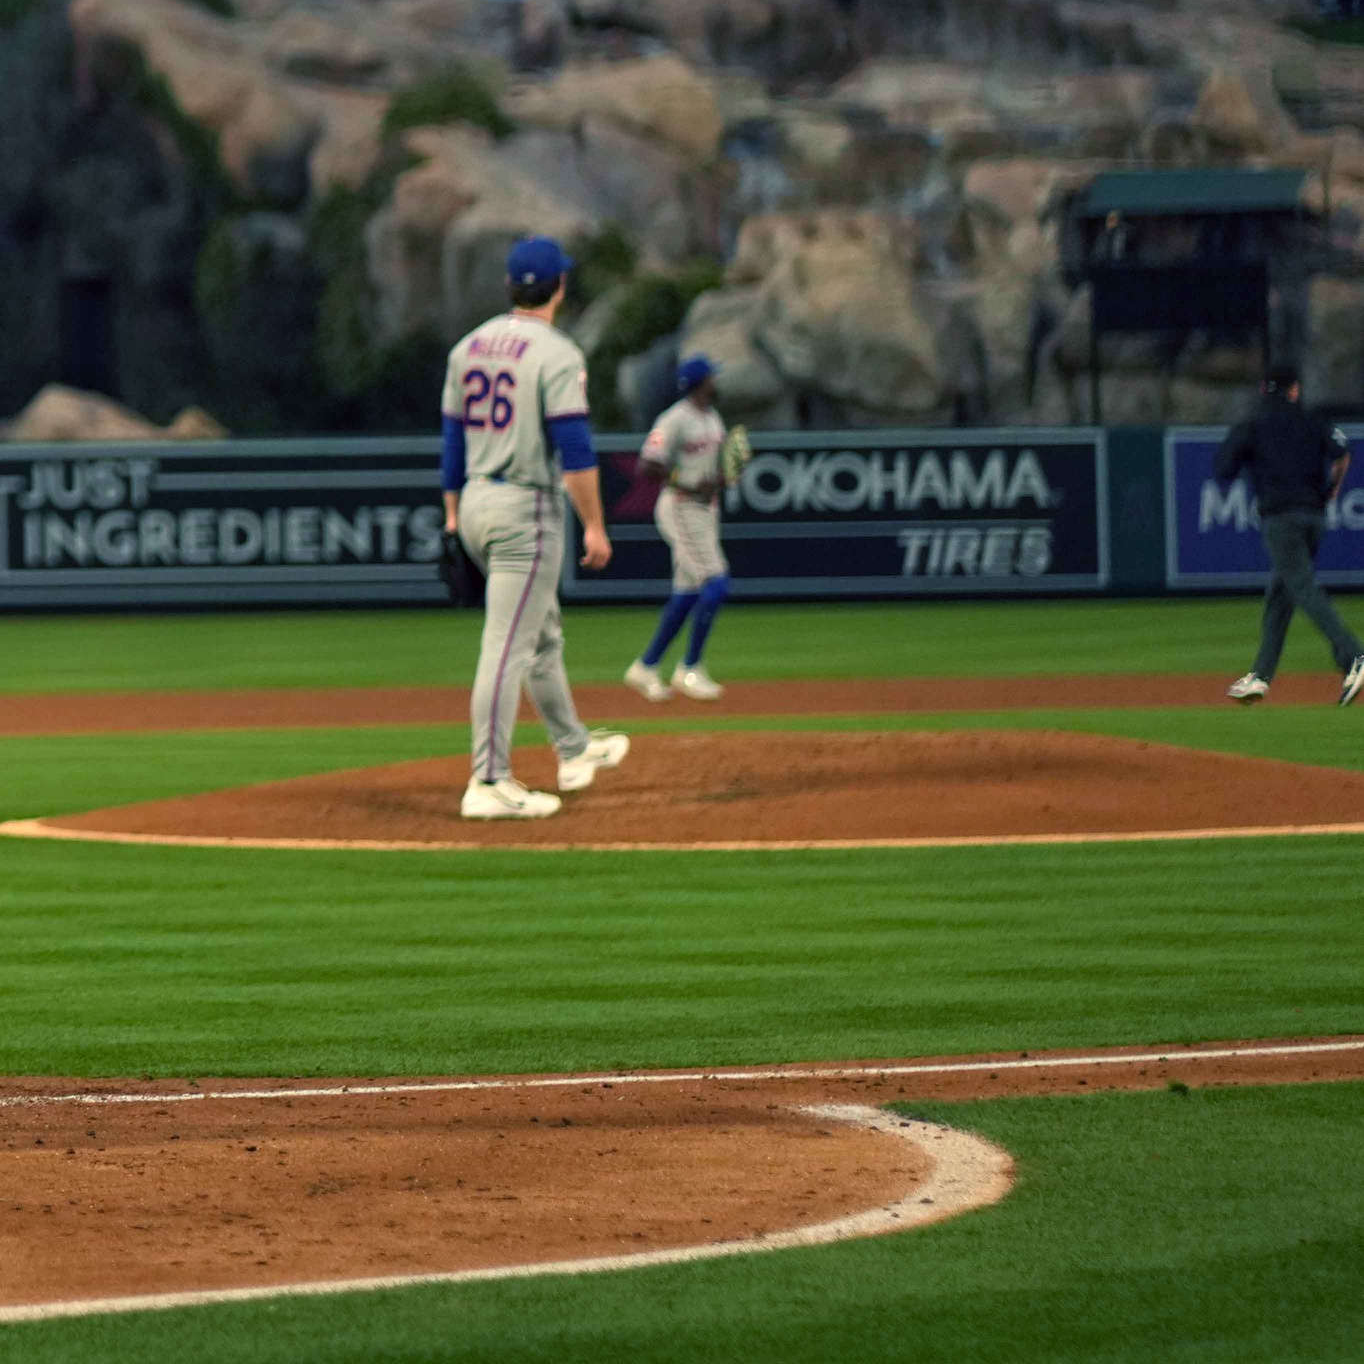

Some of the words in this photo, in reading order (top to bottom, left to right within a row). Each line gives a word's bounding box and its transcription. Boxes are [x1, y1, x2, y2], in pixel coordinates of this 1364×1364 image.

[462, 369, 516, 431] 26
[18, 458, 161, 510] JUST
[21, 504, 446, 567] INGREDIENTS
[897, 526, 1053, 577] TIRES
